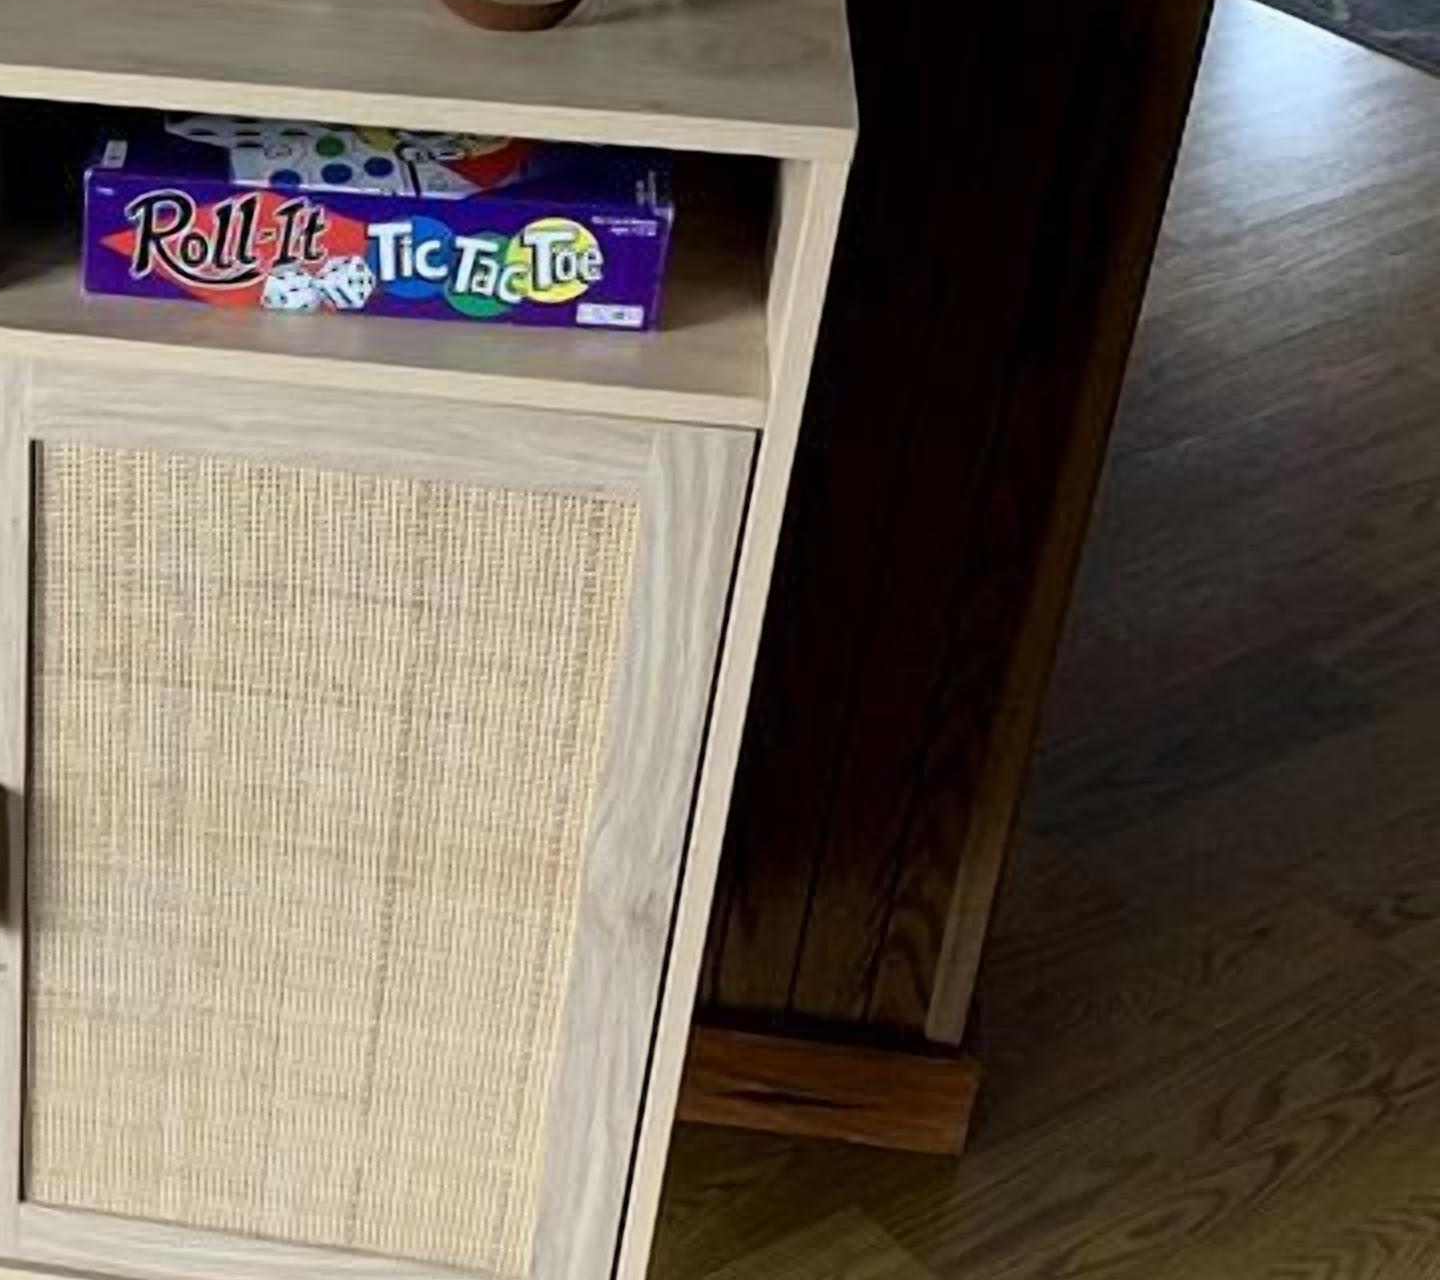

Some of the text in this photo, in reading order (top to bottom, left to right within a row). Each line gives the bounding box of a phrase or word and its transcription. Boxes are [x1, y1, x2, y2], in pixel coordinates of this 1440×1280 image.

[123, 188, 603, 304] Roll-It Tic Tac Toe
